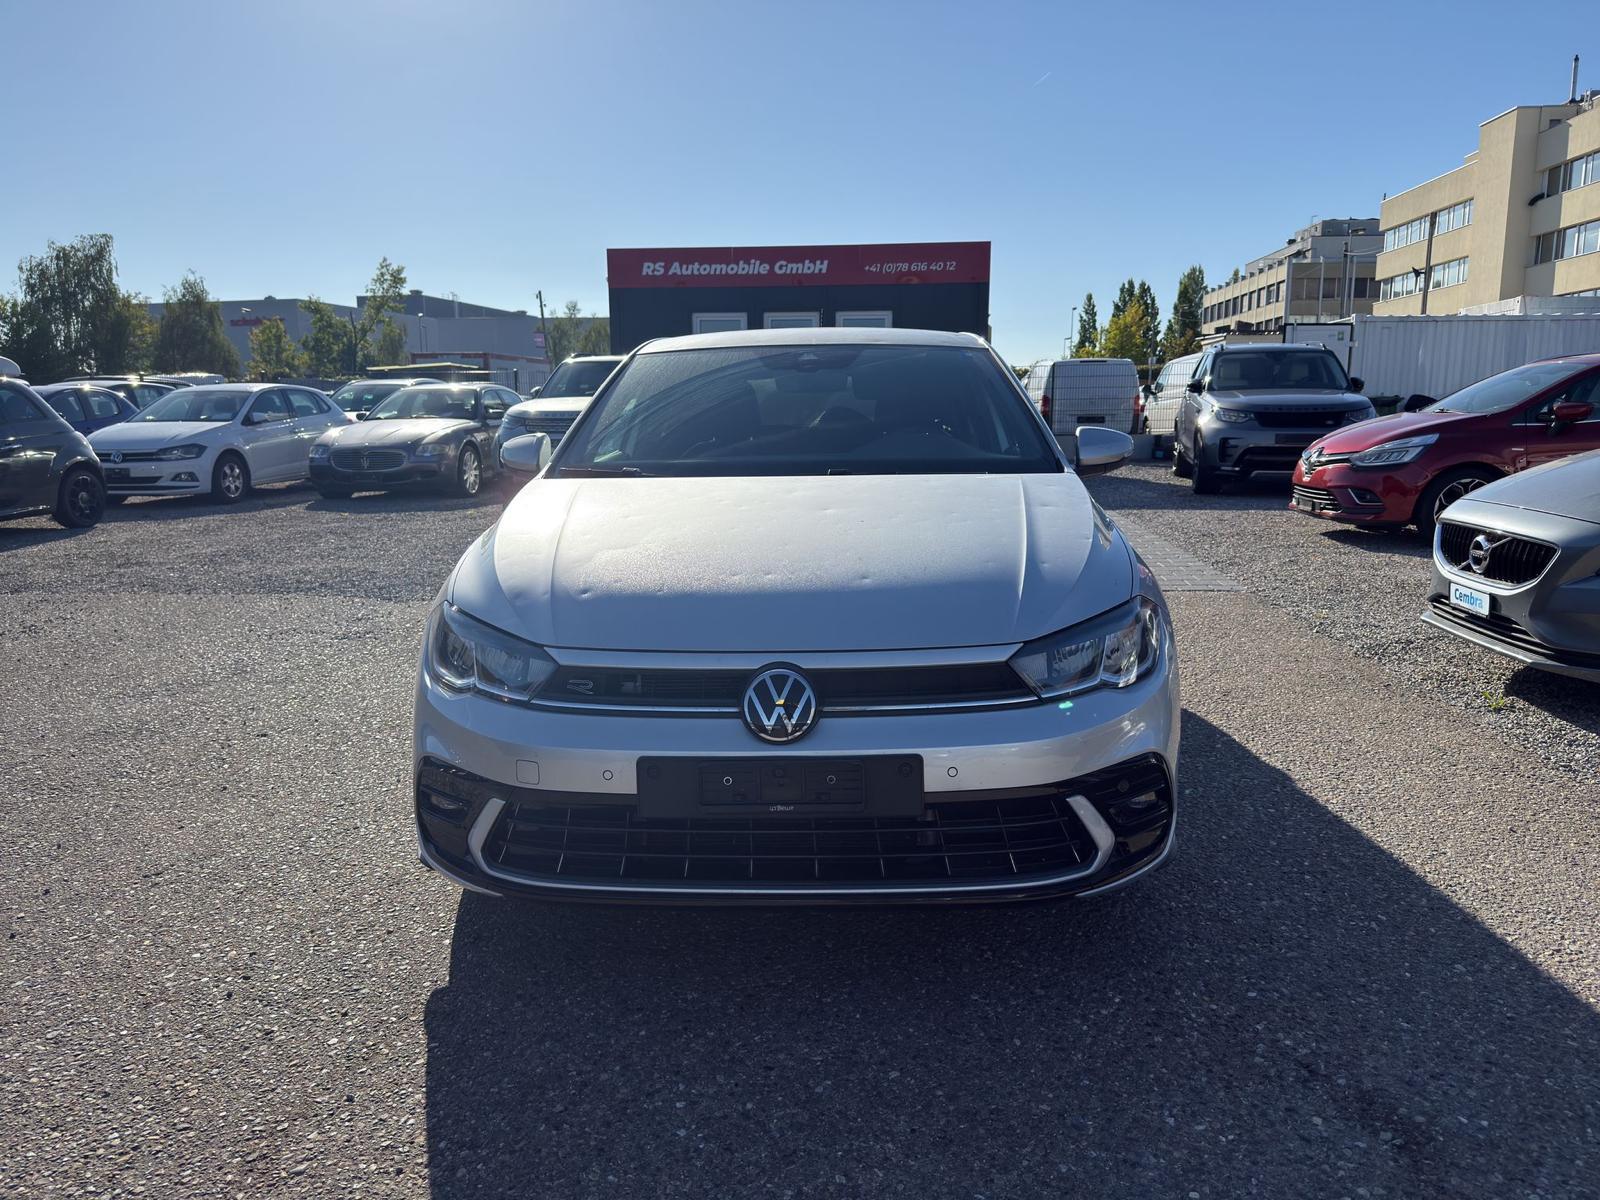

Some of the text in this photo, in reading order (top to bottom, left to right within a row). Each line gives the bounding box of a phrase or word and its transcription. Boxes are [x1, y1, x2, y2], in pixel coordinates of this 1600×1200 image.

[641, 259, 829, 276] RS Automobile GmbH
[864, 261, 956, 274] +41 (0)78 616 40 12
[1454, 588, 1483, 609] Cembra
[746, 671, 814, 738] VW
